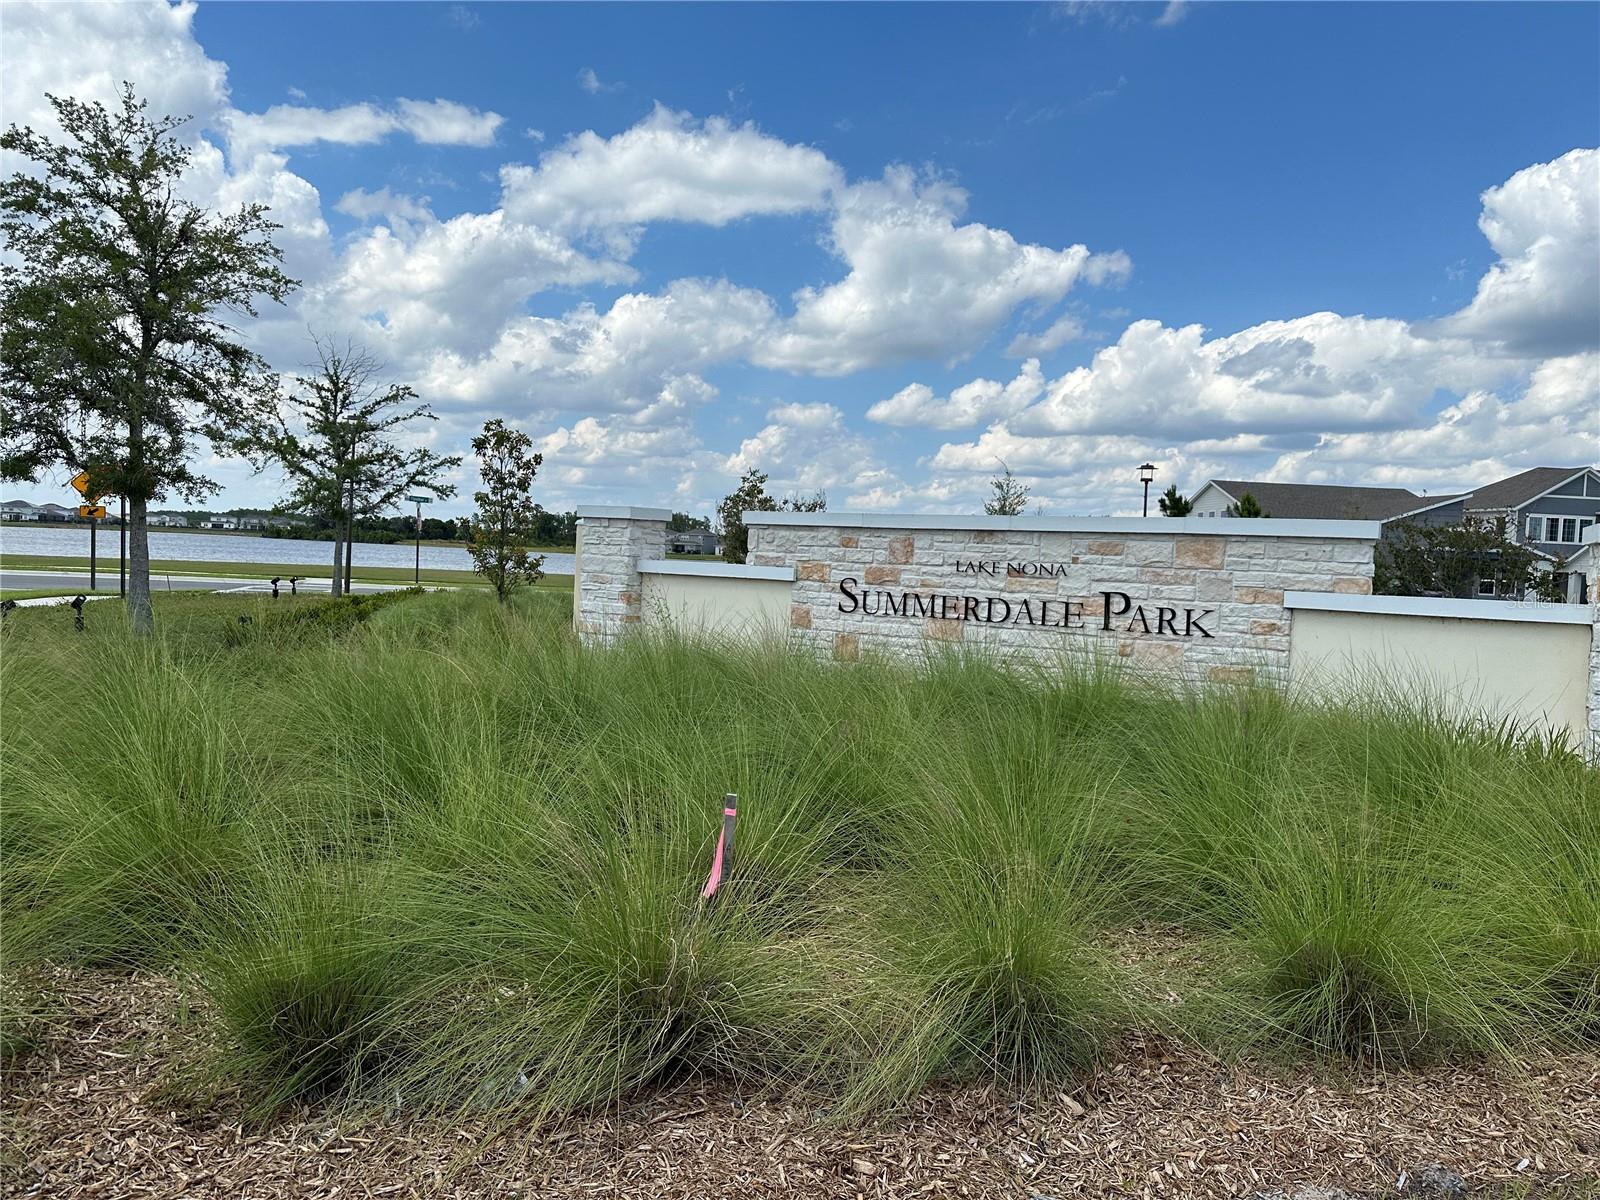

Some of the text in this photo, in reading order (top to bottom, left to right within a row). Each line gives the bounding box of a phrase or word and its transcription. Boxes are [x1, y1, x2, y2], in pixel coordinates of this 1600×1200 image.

[955, 560, 1068, 577] LAKE NONA
[838, 577, 1215, 638] SUMMERDALE PARK
